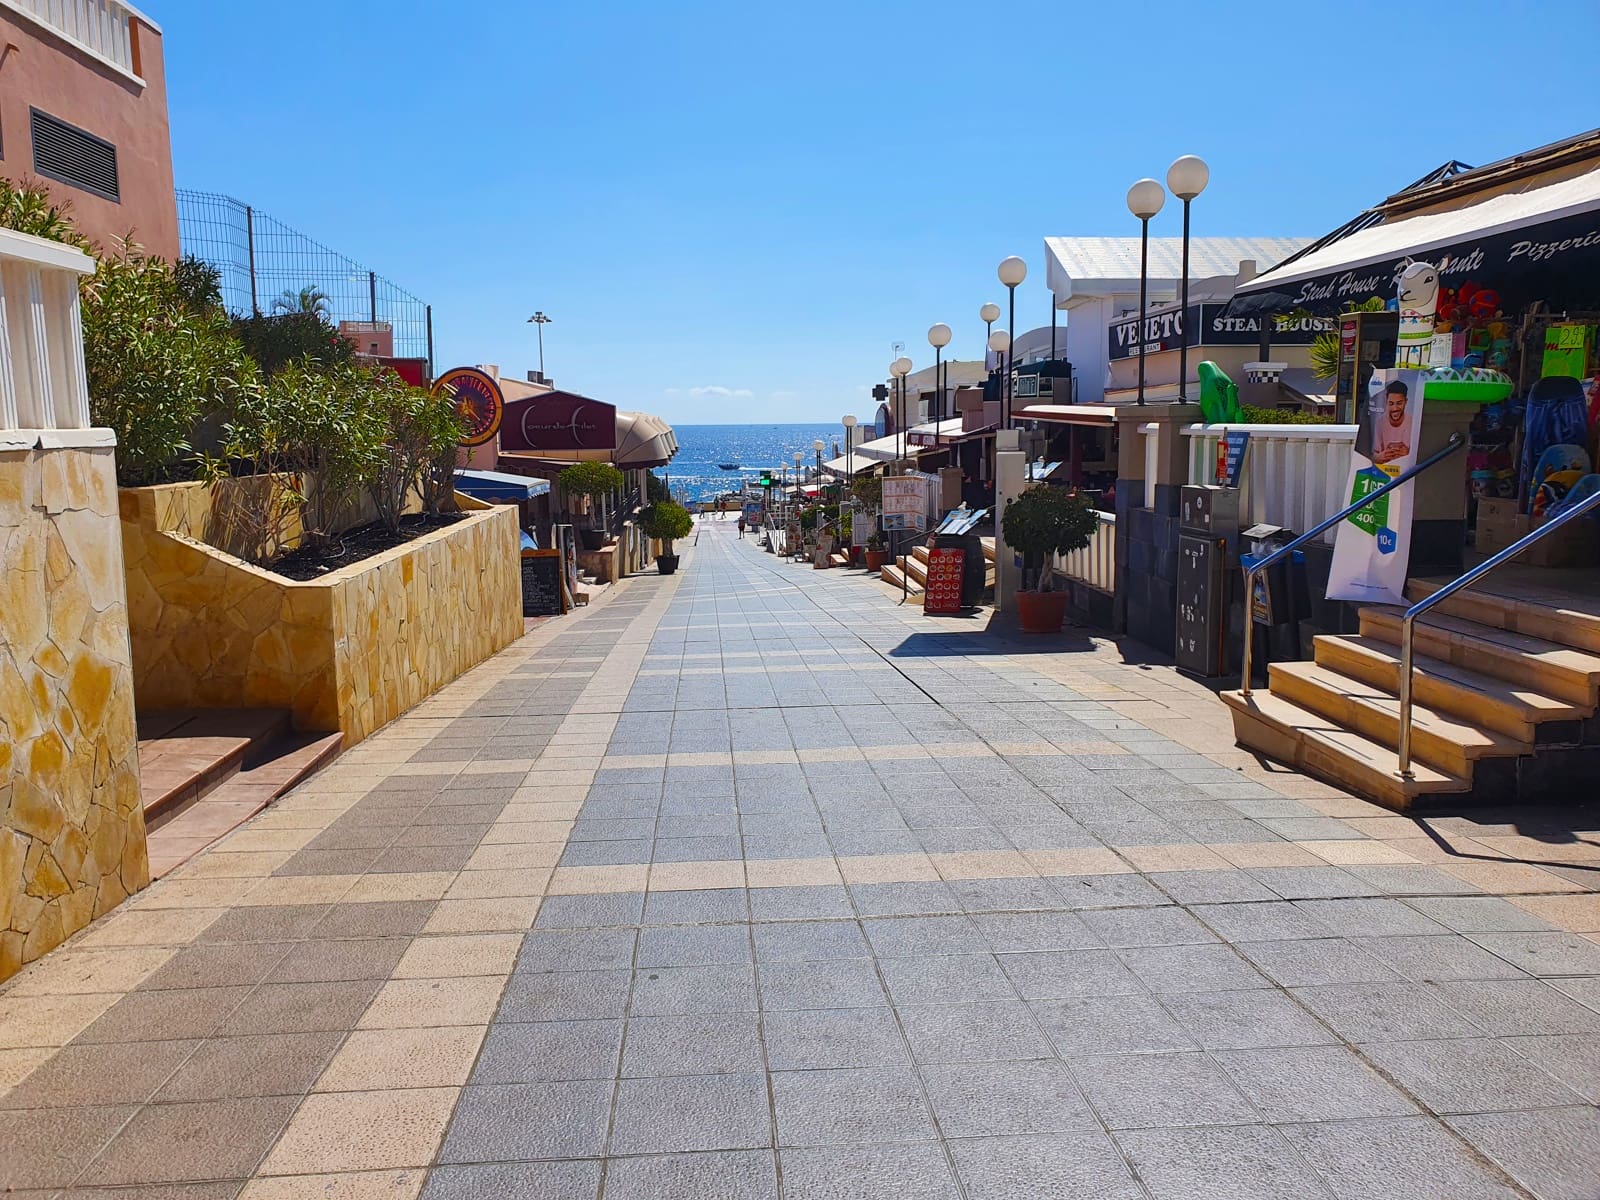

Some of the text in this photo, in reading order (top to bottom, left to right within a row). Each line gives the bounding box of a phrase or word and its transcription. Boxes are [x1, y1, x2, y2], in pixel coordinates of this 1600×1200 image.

[1293, 276, 1337, 304] Steak
[1338, 272, 1380, 296] House
[1213, 318, 1268, 332] STEA
